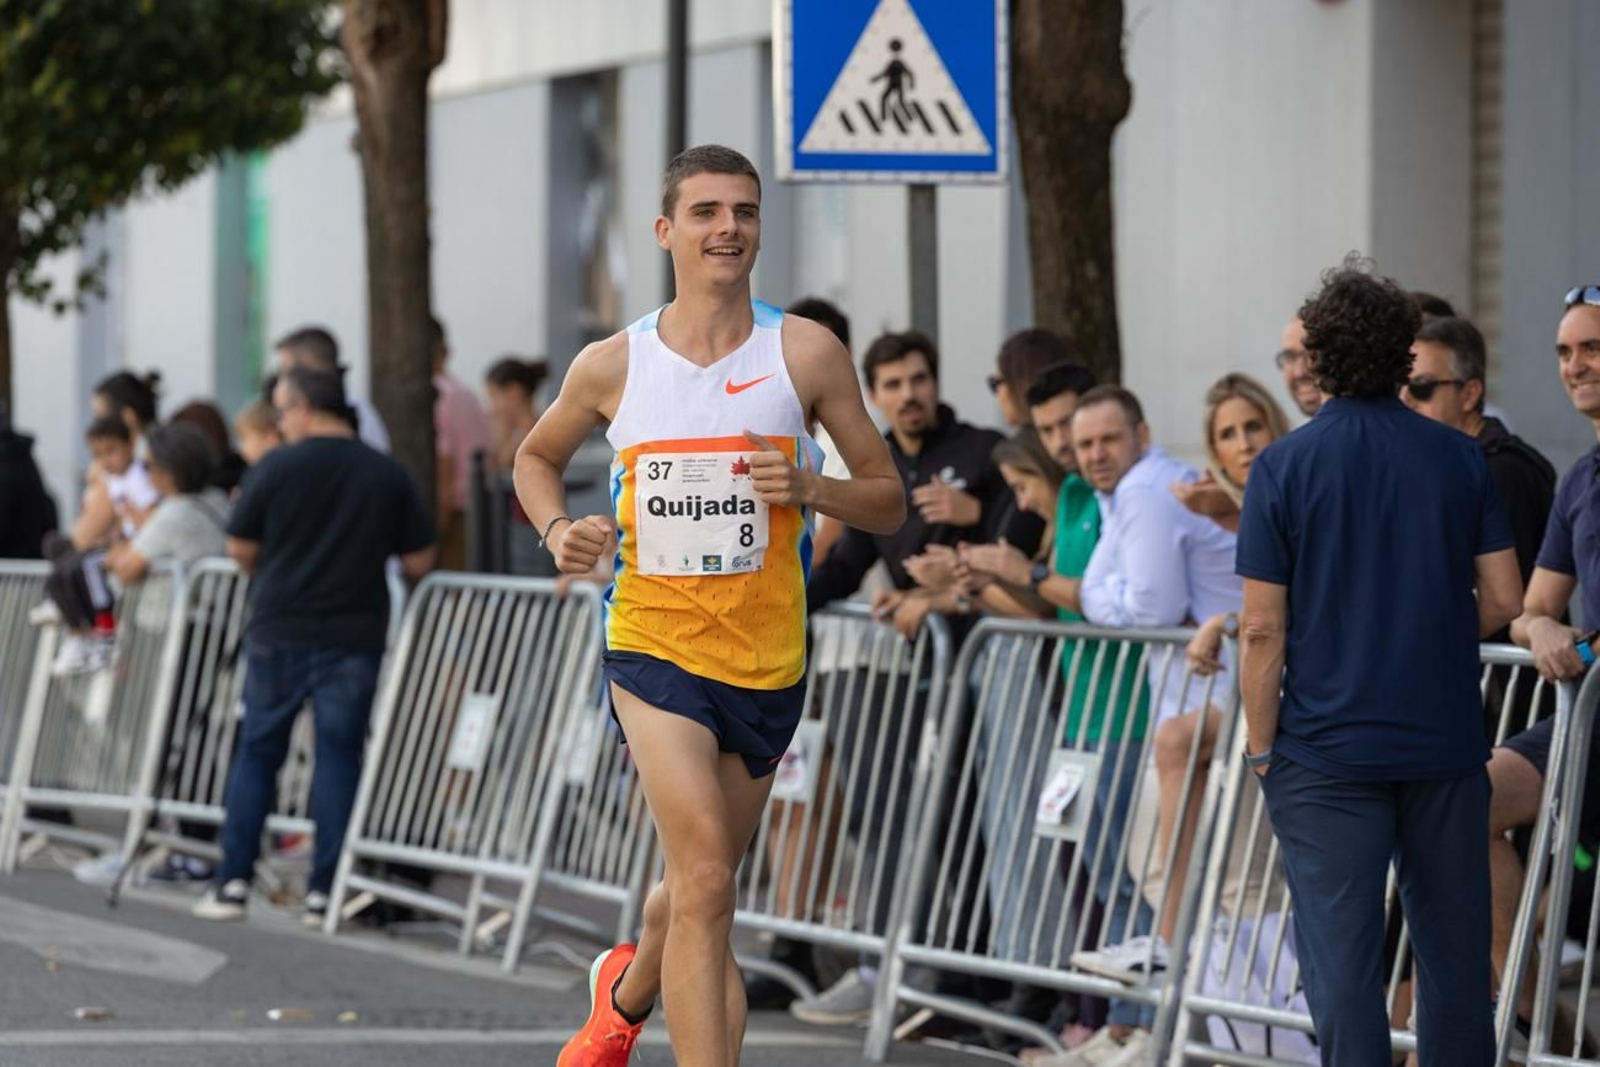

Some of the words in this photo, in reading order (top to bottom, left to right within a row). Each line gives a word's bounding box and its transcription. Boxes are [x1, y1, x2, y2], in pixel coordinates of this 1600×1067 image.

[647, 461, 673, 481] 37
[647, 494, 756, 521] Quijada
[739, 523, 754, 547] 8
